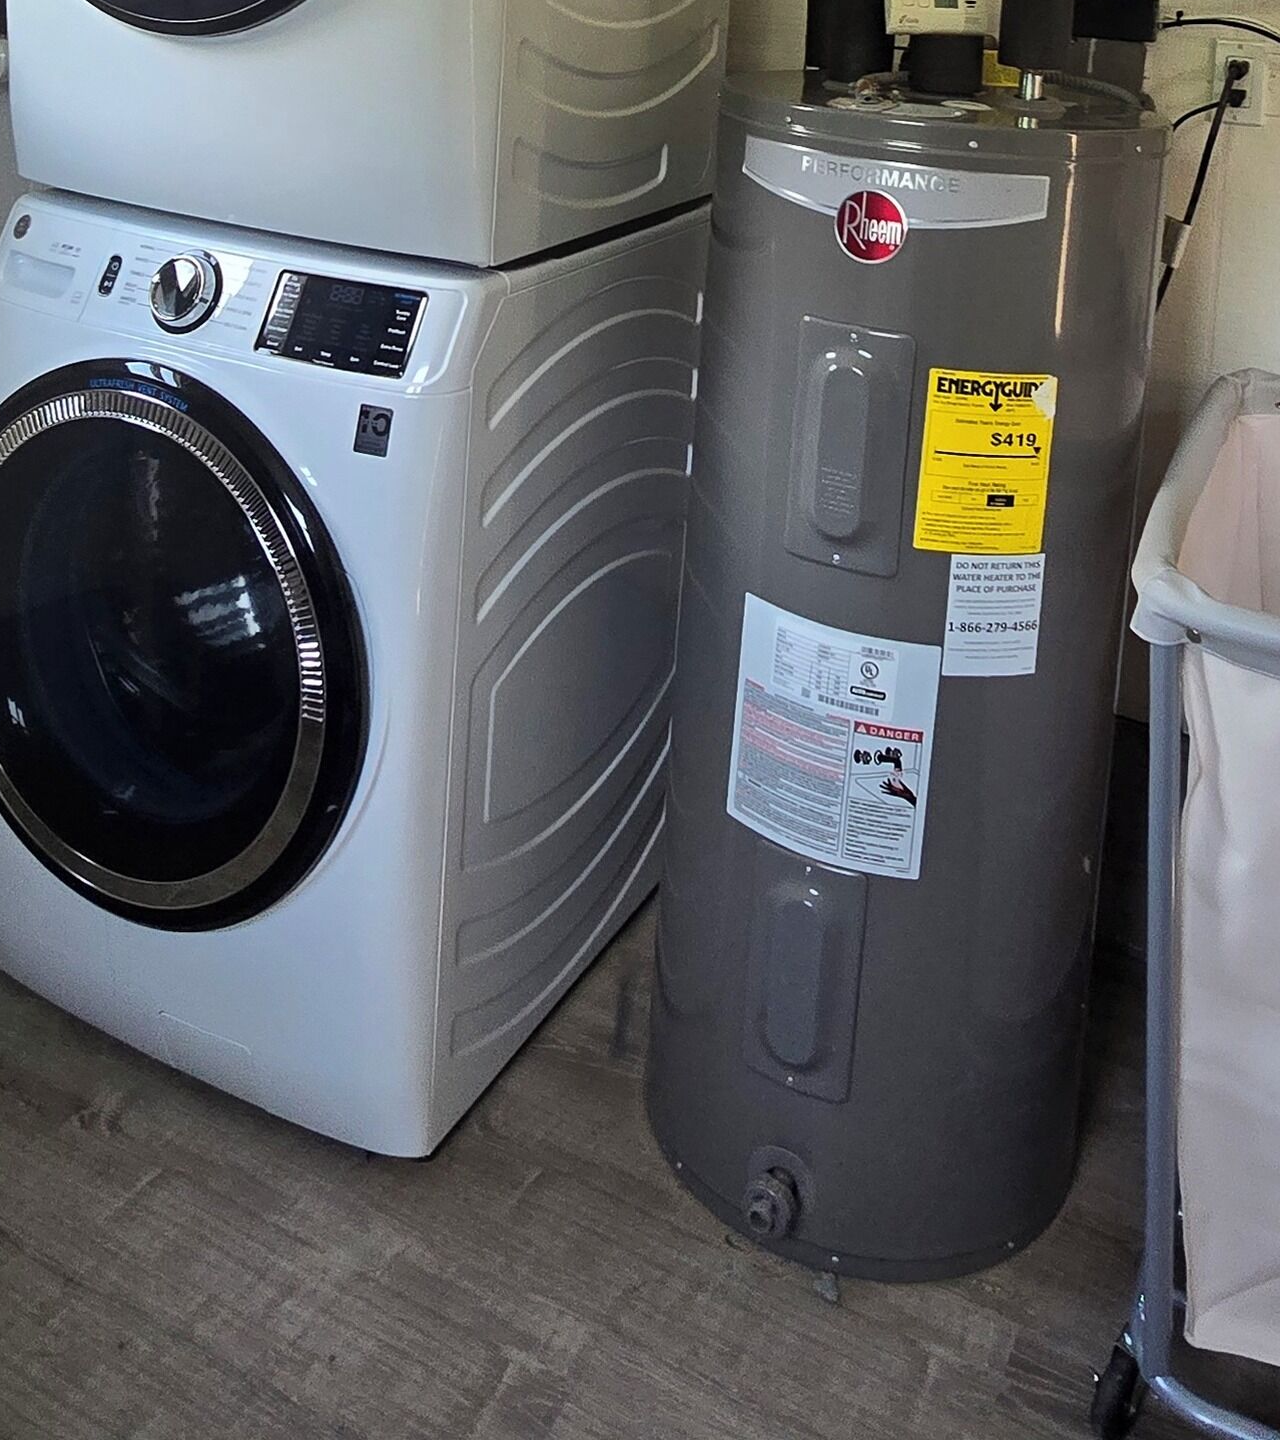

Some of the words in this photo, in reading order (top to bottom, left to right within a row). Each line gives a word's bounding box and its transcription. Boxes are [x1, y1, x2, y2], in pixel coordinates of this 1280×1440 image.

[800, 154, 962, 194] PERFORMANCE
[842, 191, 903, 251] Rheem
[936, 376, 1044, 403] ENERGYGUID
[138, 383, 158, 396] VENT
[160, 389, 189, 412] SYSTEM
[955, 561, 969, 570] DO
[971, 561, 989, 570] NOT
[990, 561, 1022, 570] RETURN
[1024, 560, 1041, 569] THIS
[952, 573, 982, 582] WATER
[983, 573, 1014, 582] HEATER
[1015, 573, 1026, 581] TO
[1027, 572, 1041, 581] THE
[955, 585, 982, 594] PLACE
[983, 585, 995, 593] OF
[996, 584, 1037, 593] PURCHASE
[948, 620, 1038, 633] 1-866-279-4566
[869, 727, 920, 742] DANGER
